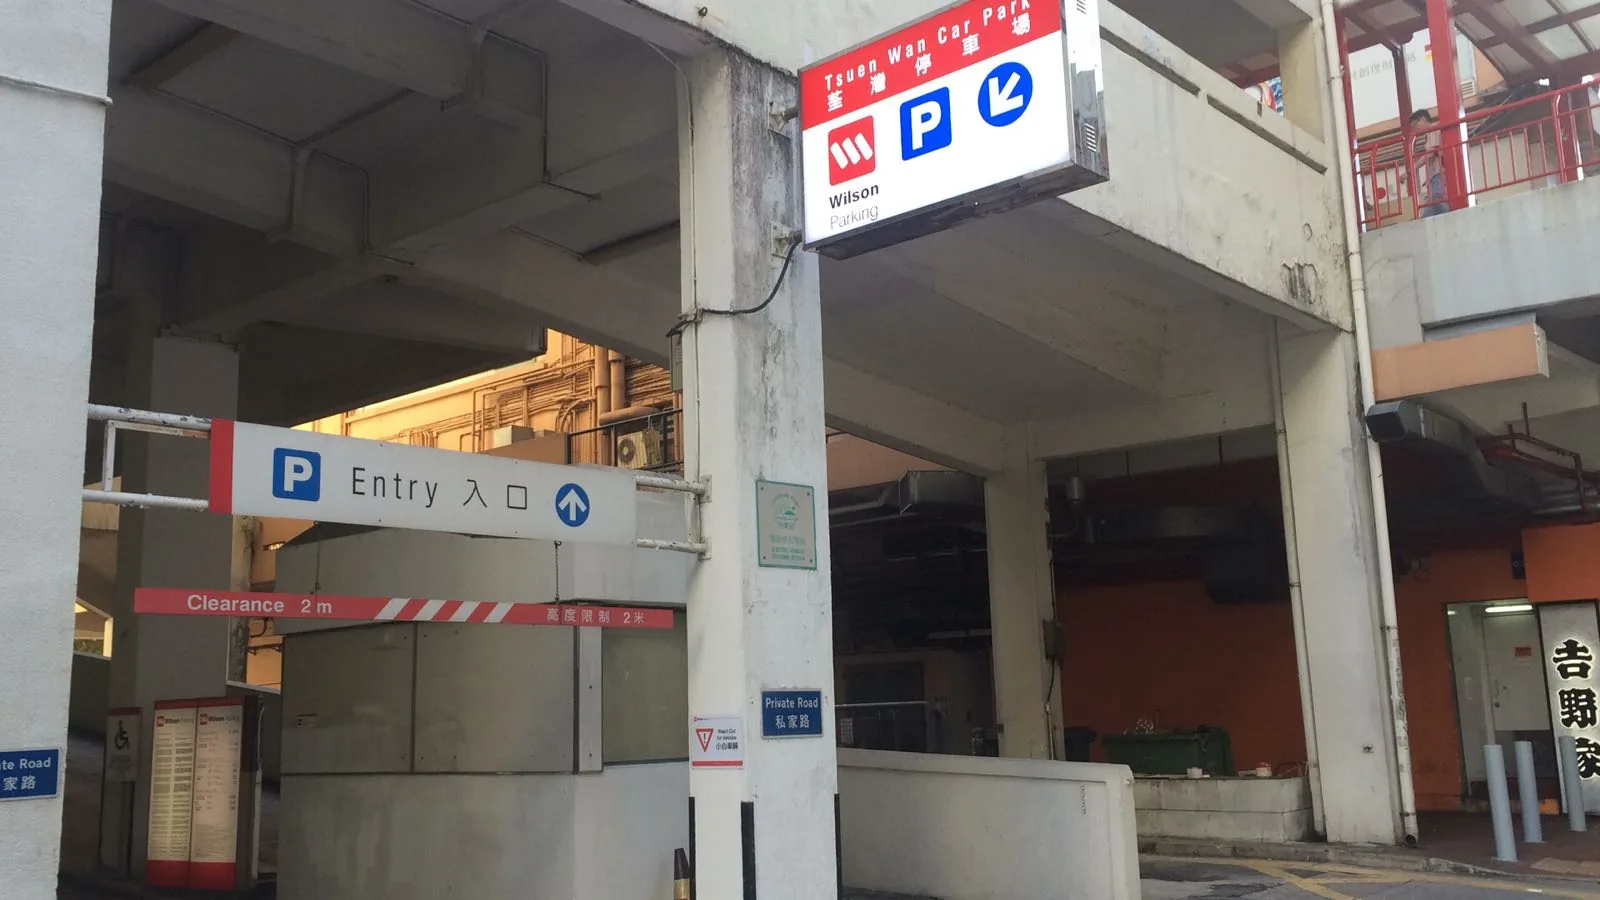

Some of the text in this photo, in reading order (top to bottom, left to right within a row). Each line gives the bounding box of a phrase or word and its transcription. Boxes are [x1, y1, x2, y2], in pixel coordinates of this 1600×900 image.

[824, 0, 1031, 91] Tsuen Wan Car Park
[826, 12, 1031, 112] 荃灣停車場
[829, 184, 879, 209] Wilson
[830, 205, 879, 230] Parking
[352, 466, 528, 511] Entry 入口
[187, 593, 332, 614] Clearance 2 m
[546, 607, 610, 623] 高度限制
[765, 697, 819, 708] Private Road
[775, 714, 810, 729] 私家路
[0, 757, 51, 770] te Road
[3, 775, 36, 791] 家路
